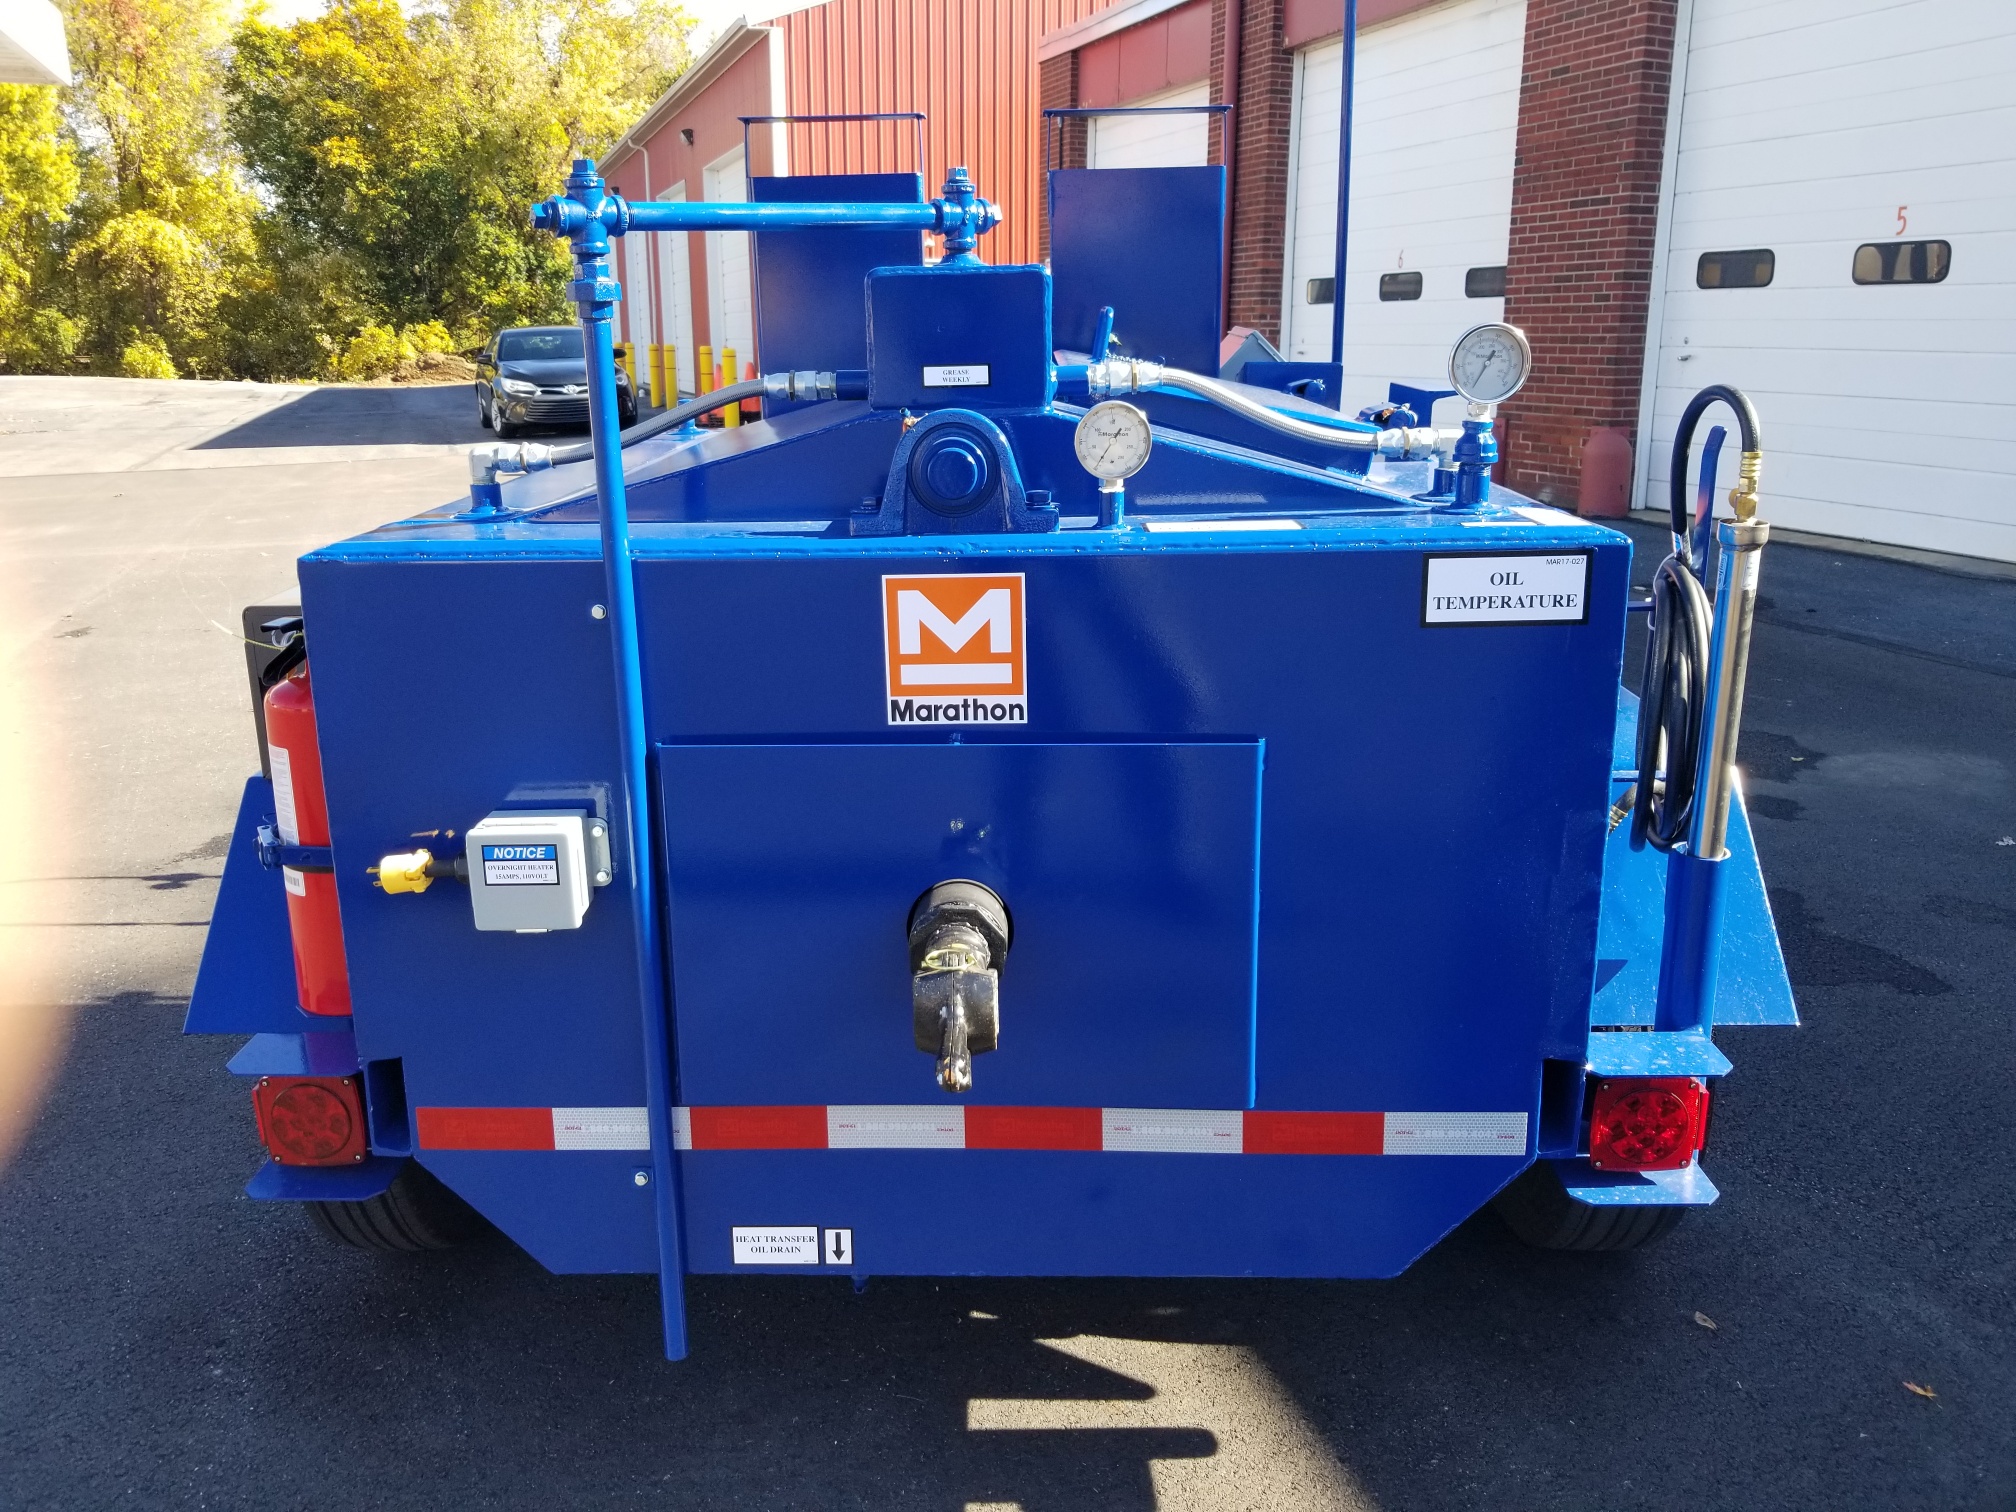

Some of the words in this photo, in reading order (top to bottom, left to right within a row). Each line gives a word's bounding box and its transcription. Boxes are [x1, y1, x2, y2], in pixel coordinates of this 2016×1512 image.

[1895, 205, 1908, 236] 5
[1397, 248, 1404, 269] 6
[1545, 557, 1585, 566] MAR17-027
[1489, 571, 1524, 586] OIL
[1432, 593, 1578, 611] TEMPERATURE
[890, 697, 1025, 722] Marathon
[493, 847, 546, 859] NOTICE
[735, 1235, 762, 1243] HEAT
[763, 1235, 816, 1243] TRANSFER
[750, 1245, 769, 1254] OIL
[770, 1245, 802, 1253] DRAIN
